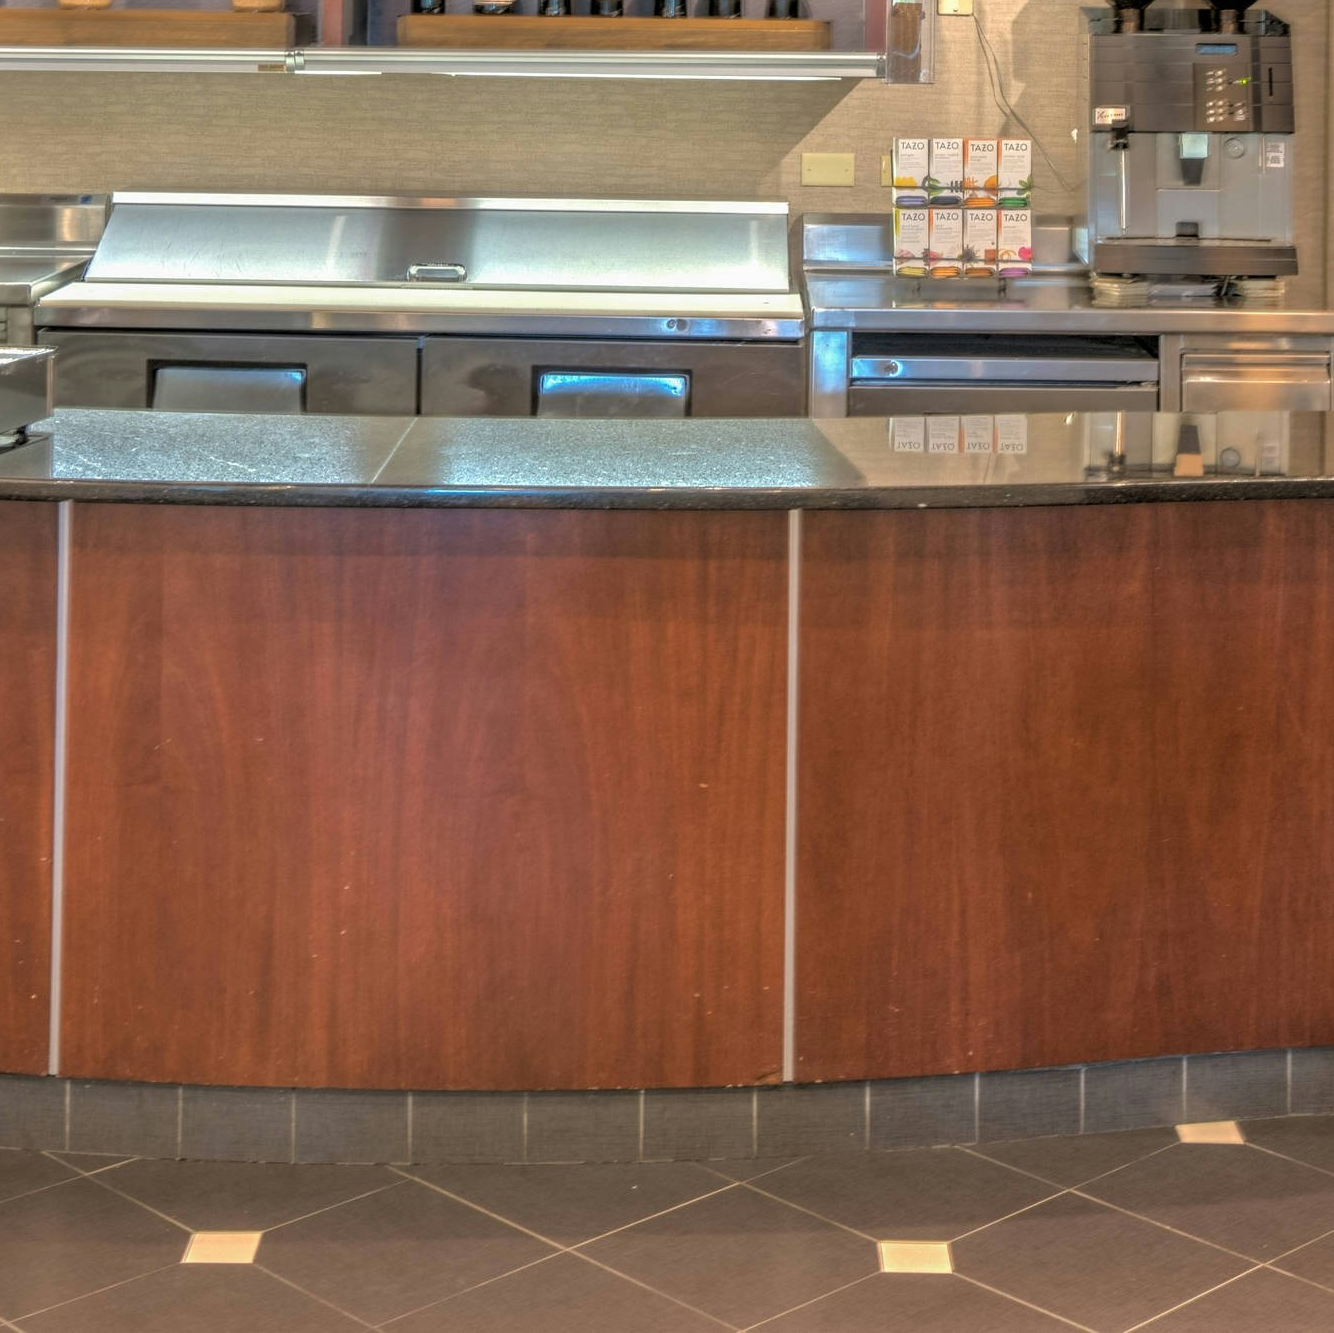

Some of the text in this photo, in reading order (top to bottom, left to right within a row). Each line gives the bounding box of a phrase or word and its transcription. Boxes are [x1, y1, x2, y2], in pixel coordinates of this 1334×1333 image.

[901, 141, 924, 150] TAZO
[935, 141, 959, 149] TAZO
[971, 144, 994, 152] TAZO
[1004, 143, 1027, 151] TAZO
[902, 213, 925, 221] TAZO
[935, 213, 959, 221] TAZO
[969, 213, 993, 221] TAZO
[1004, 214, 1027, 222] TAZO
